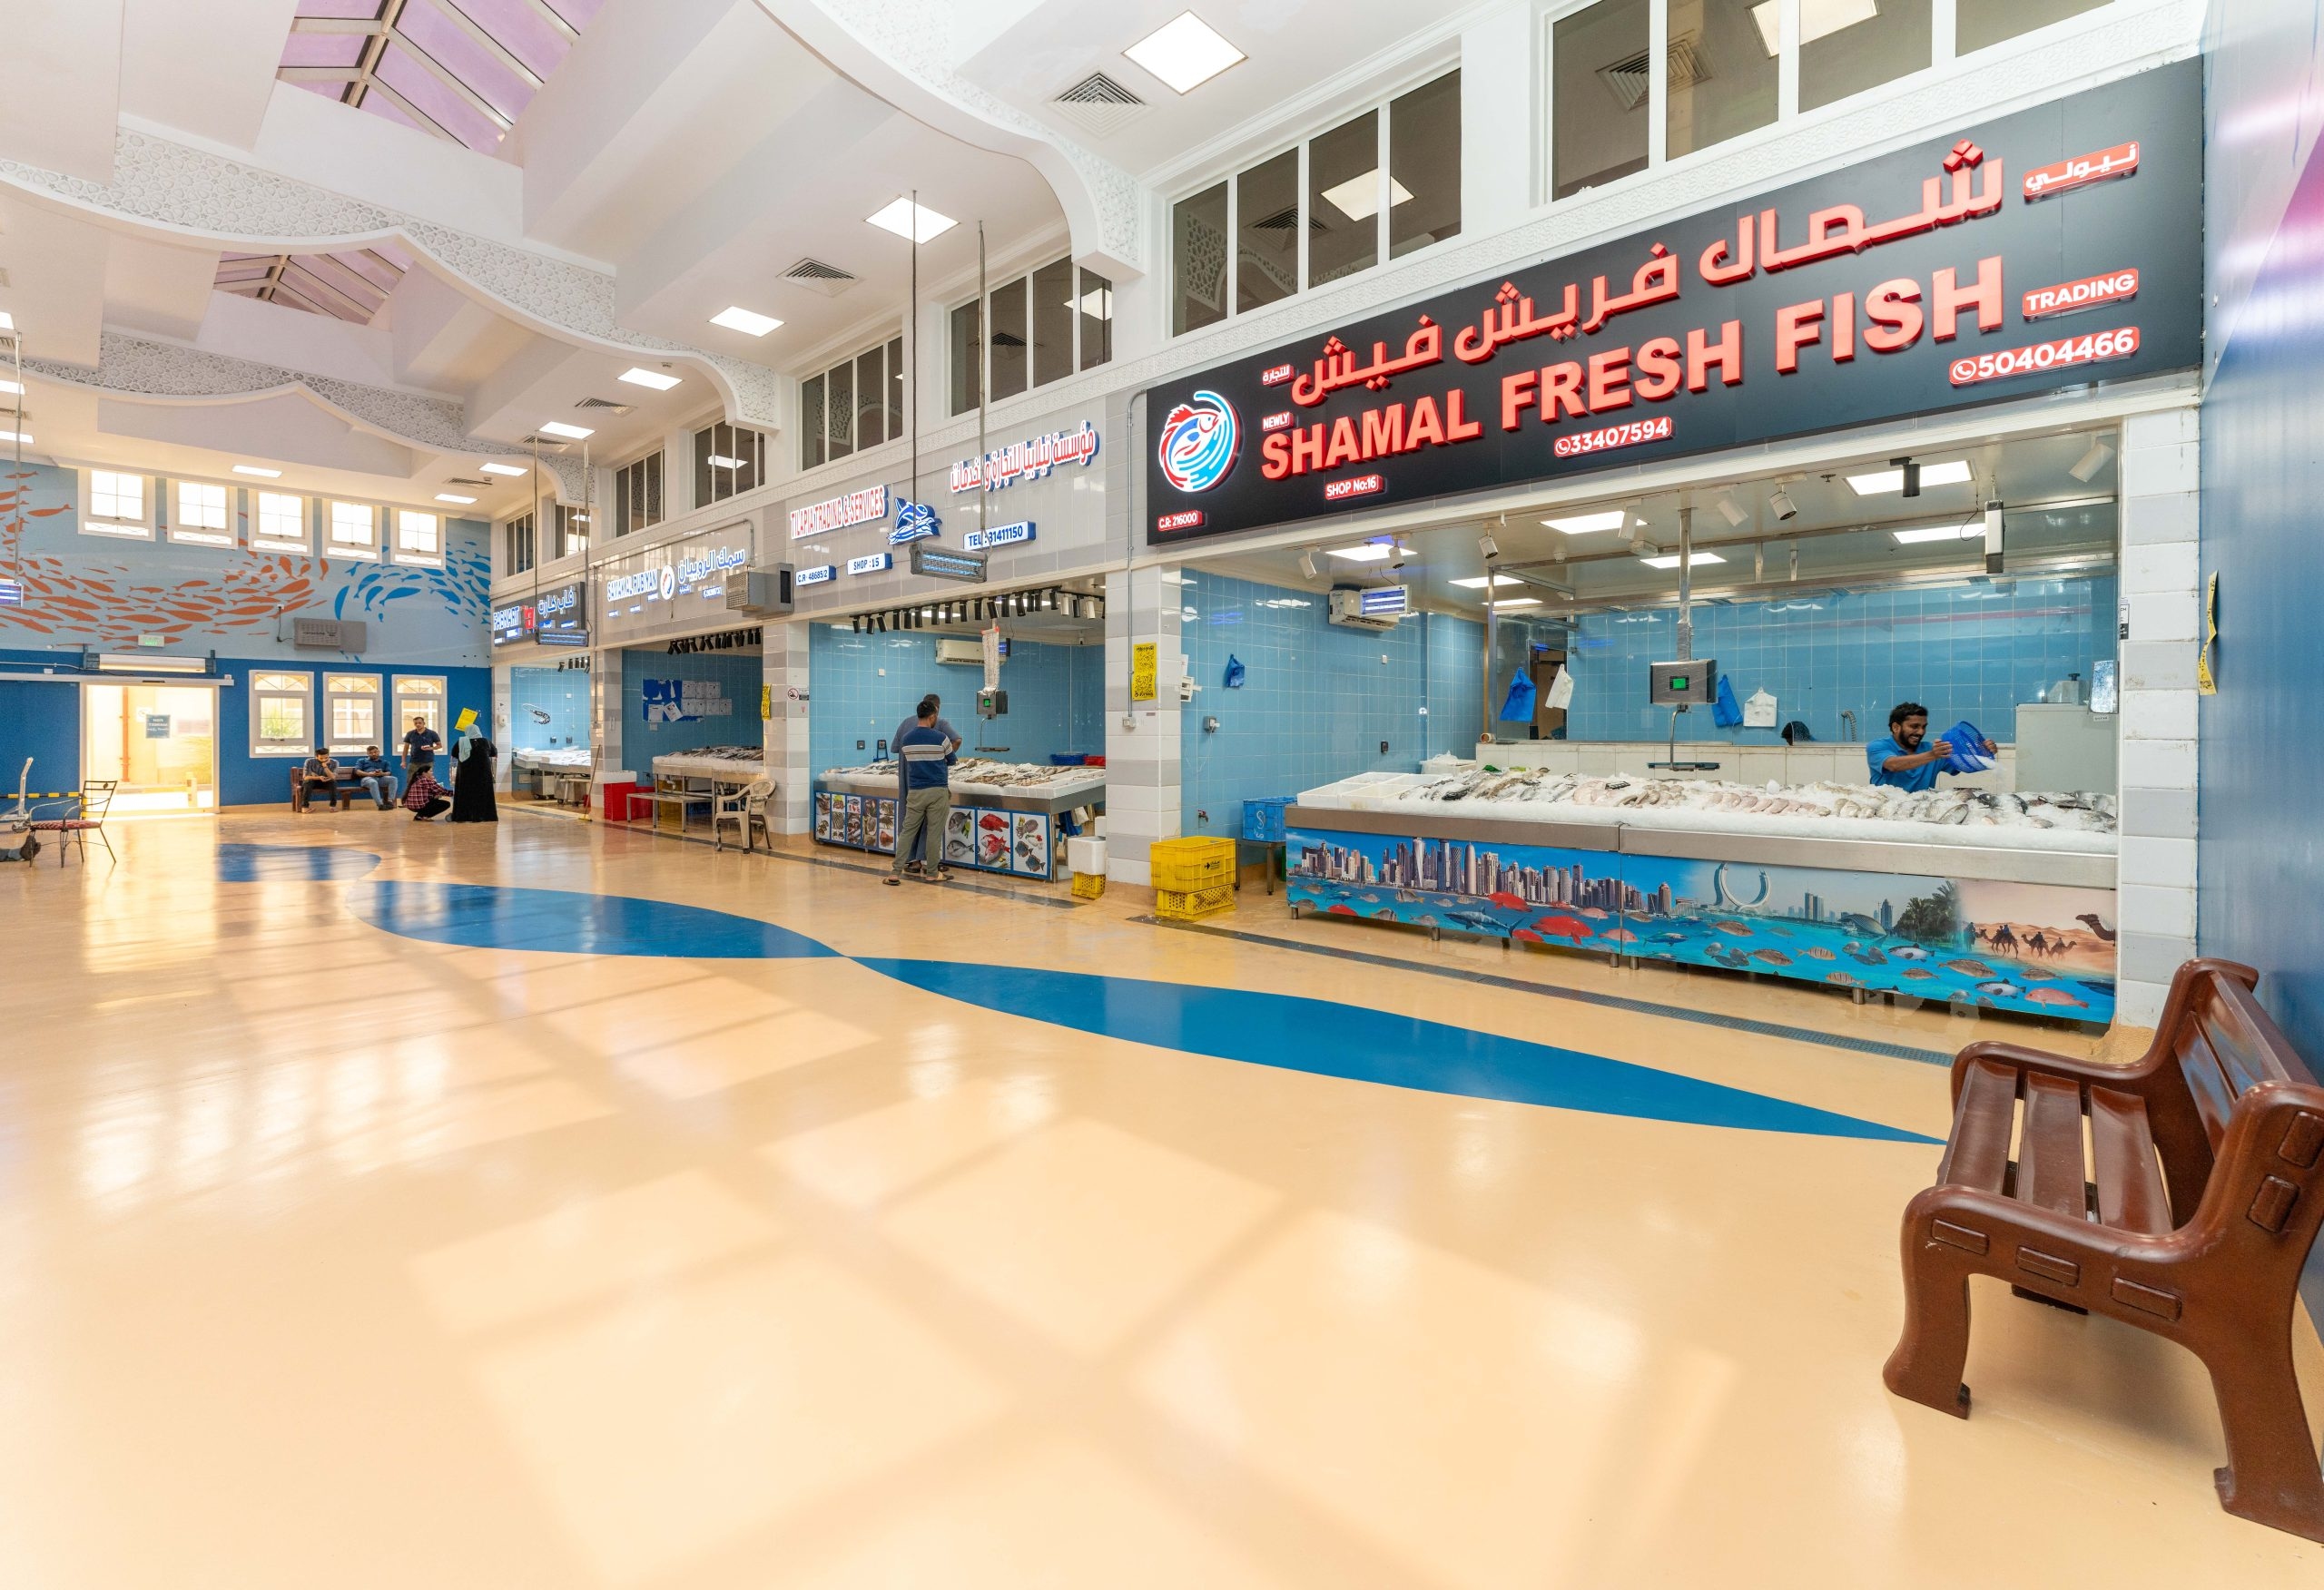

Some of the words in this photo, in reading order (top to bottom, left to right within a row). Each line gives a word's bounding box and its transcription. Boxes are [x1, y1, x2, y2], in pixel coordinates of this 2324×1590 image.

[2025, 143, 2136, 191] نيولي
[1699, 138, 2004, 285] شمال
[1453, 241, 1681, 363] فريش
[2026, 273, 2135, 309] TRADING
[1261, 388, 1482, 481] SHAMAL
[1502, 319, 1744, 432] FRESH
[1776, 255, 2004, 374] FISH
[1291, 314, 1443, 407] فيش
[1978, 329, 2134, 377] 50404466
[1263, 365, 1290, 382] للتجارة
[1263, 412, 1290, 429] NEWLY
[1571, 417, 1669, 453] 33407594
[1052, 420, 1096, 465] مؤسسة
[1326, 483, 1352, 497] SHOP
[791, 506, 814, 539] TILAPIA
[813, 496, 842, 535] TRADING
[842, 496, 850, 526] &
[849, 485, 885, 525] SERVICES
[1172, 513, 1196, 526] 216000
[716, 546, 744, 570] سمك
[853, 559, 868, 571] SHOP
